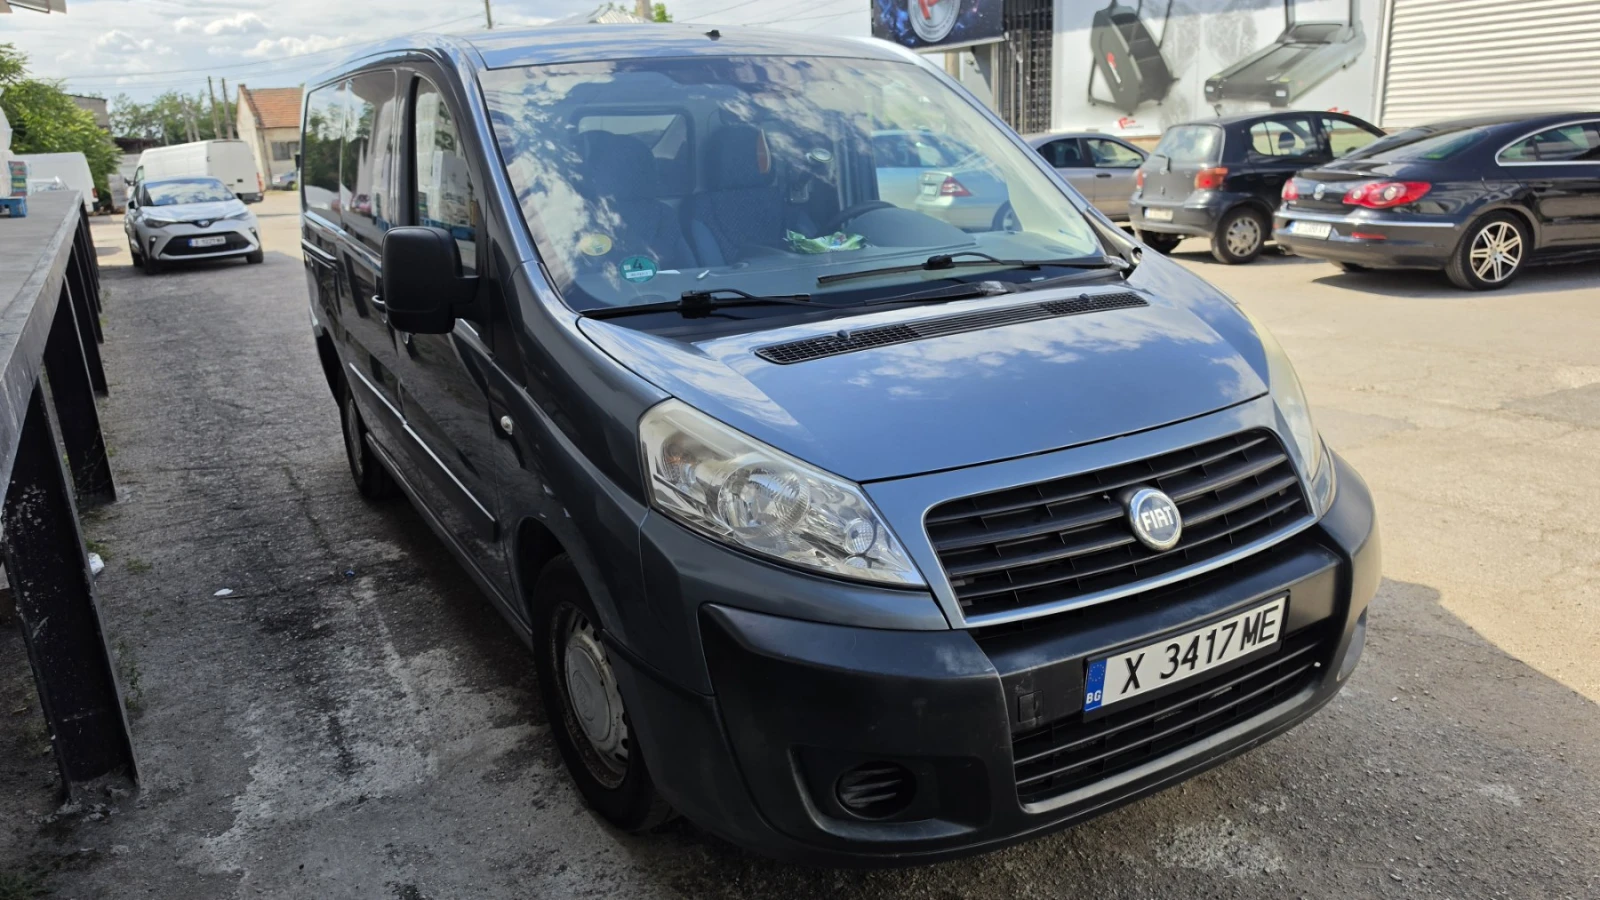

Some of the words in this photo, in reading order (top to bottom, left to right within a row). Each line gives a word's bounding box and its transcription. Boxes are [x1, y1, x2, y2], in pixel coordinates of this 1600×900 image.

[633, 258, 643, 269] 4
[1140, 506, 1174, 531] FIAT
[1121, 653, 1145, 694] X
[1160, 621, 1238, 679] 3417
[1239, 605, 1279, 651] ME
[1086, 691, 1102, 705] BG
